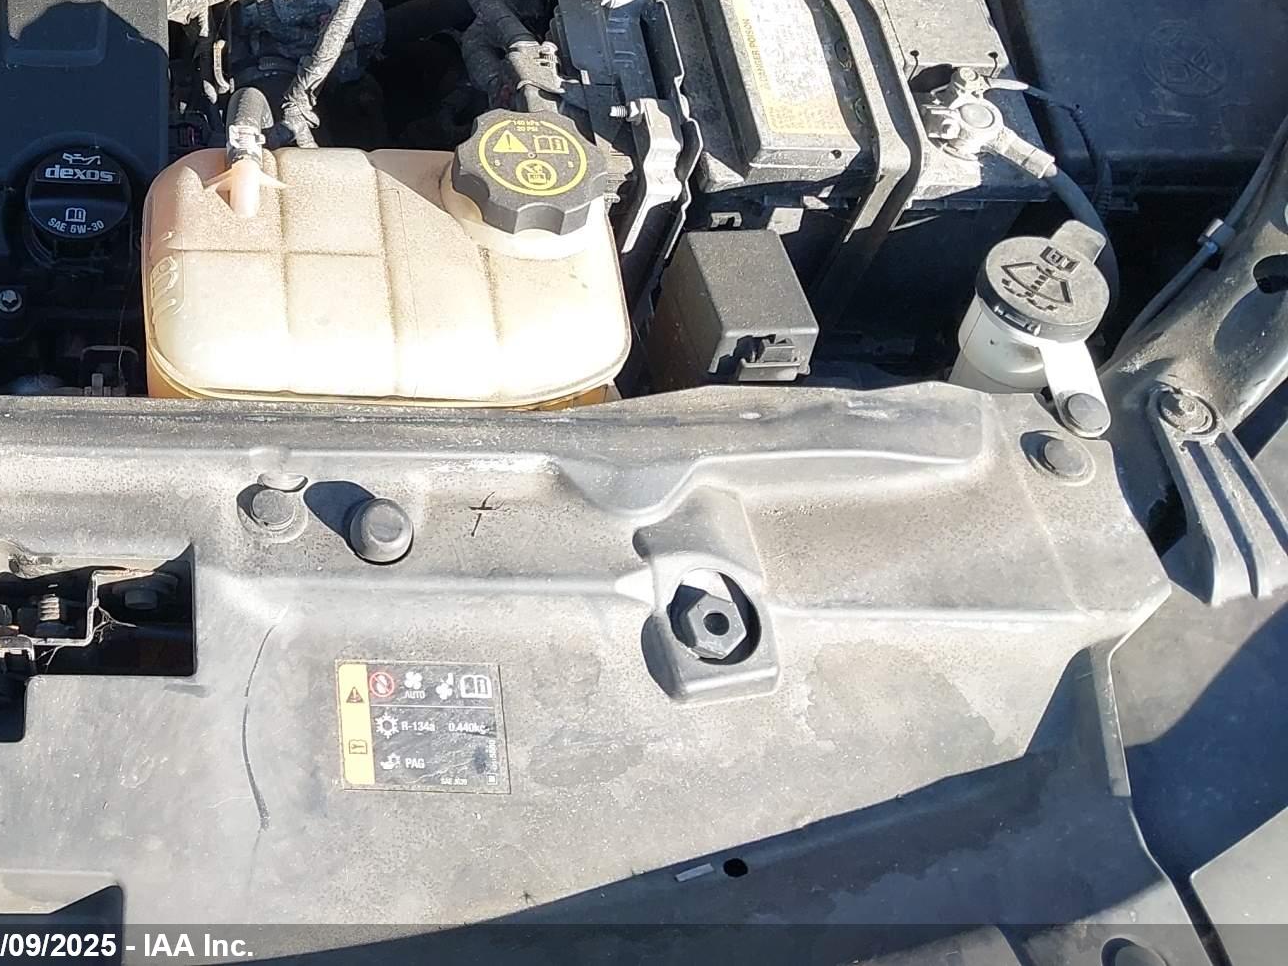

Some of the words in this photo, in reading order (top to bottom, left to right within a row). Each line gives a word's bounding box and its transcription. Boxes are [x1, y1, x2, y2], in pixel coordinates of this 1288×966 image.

[742, 18, 757, 47] POISON
[45, 165, 116, 182] dexos
[48, 218, 67, 233] SAE
[404, 690, 426, 699] AUTO
[402, 721, 436, 732] R-134a
[405, 758, 425, 769] PAG
